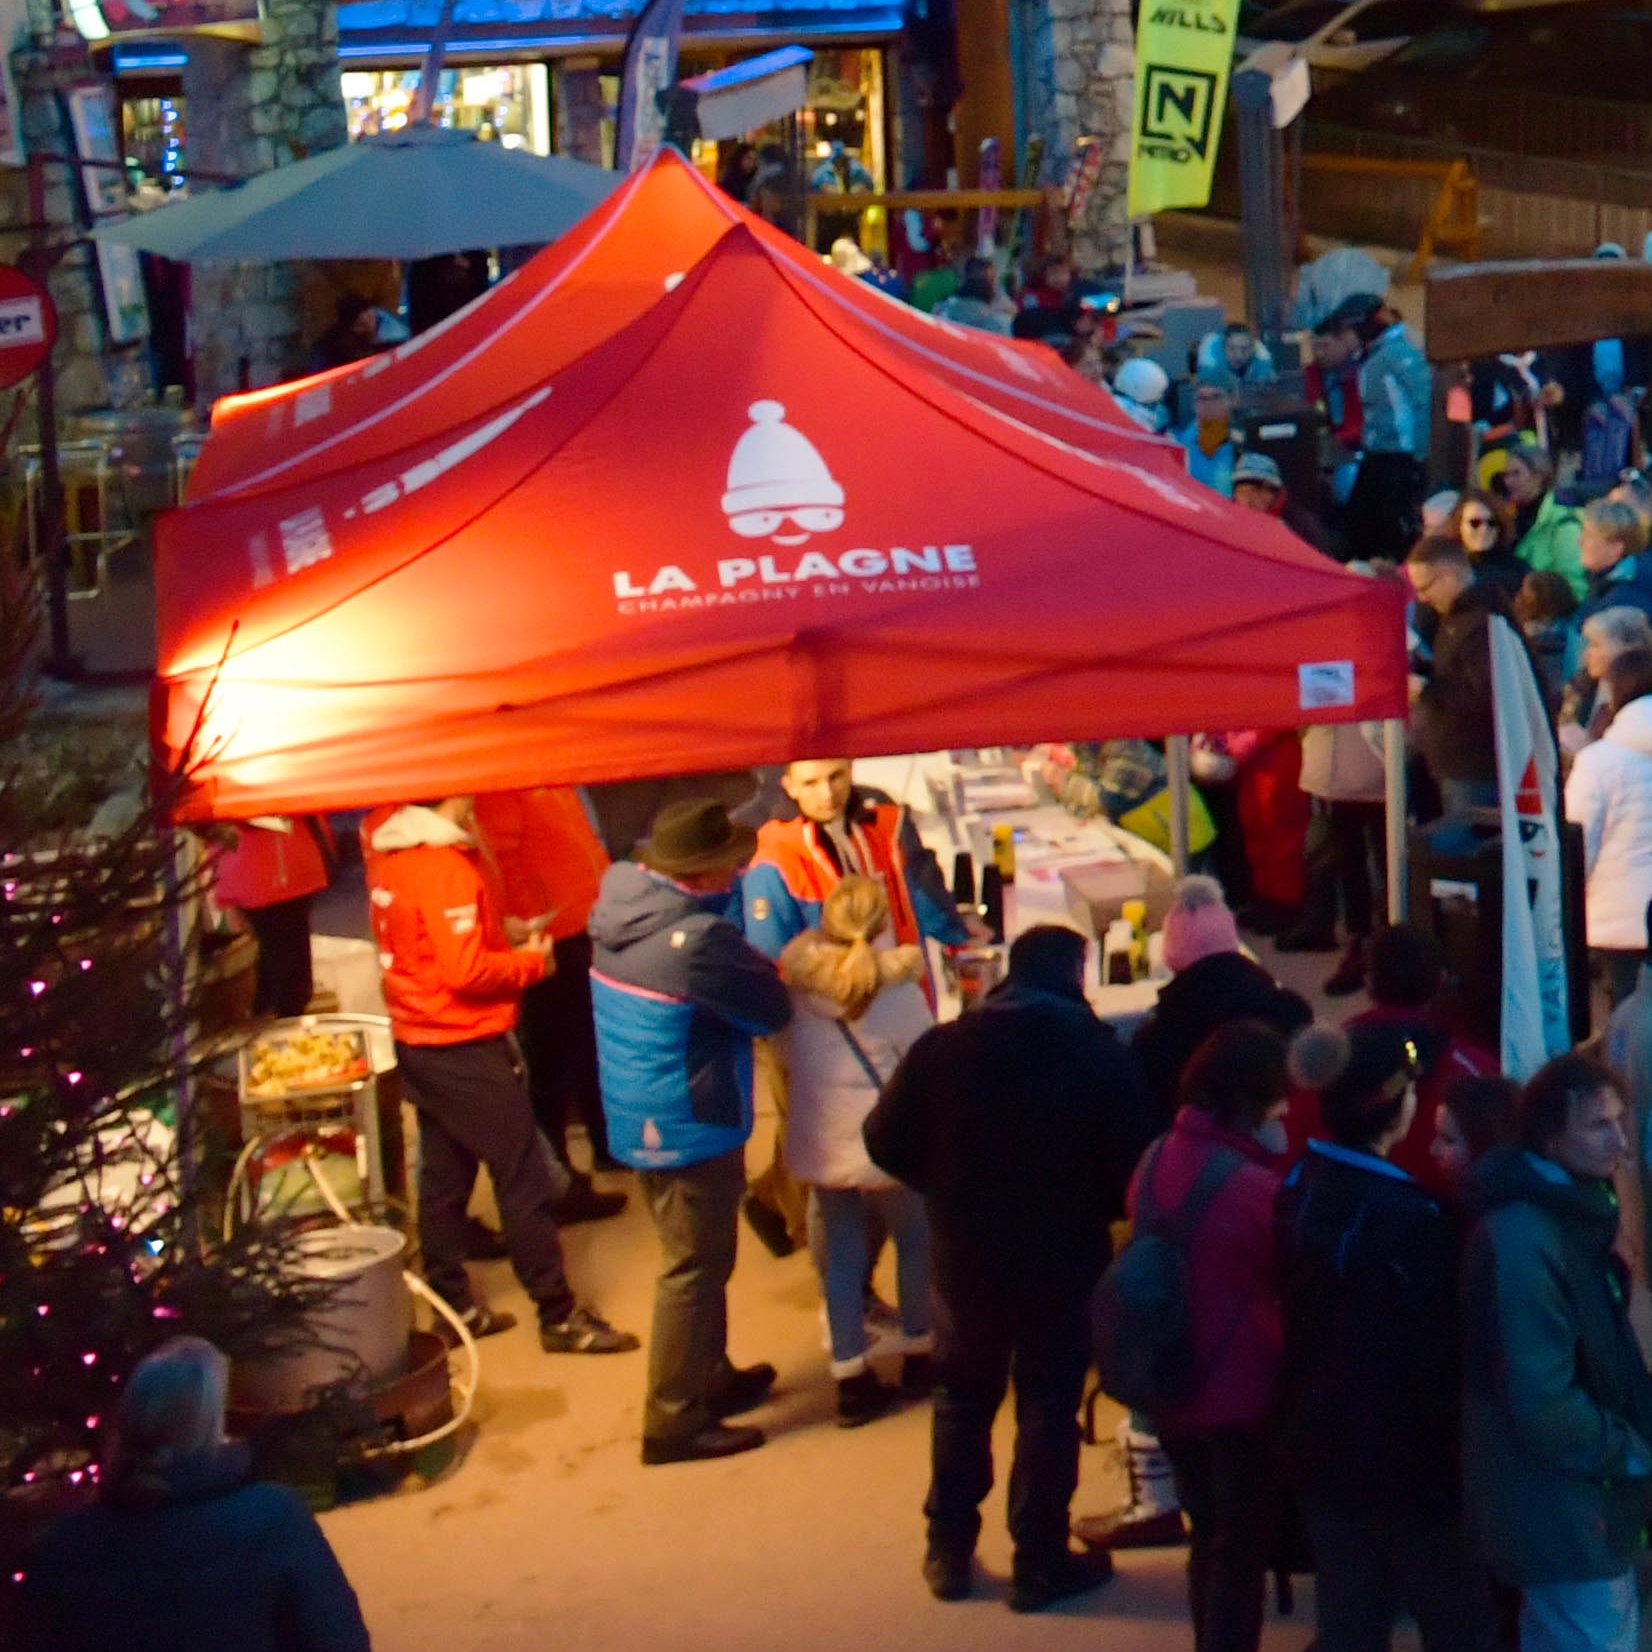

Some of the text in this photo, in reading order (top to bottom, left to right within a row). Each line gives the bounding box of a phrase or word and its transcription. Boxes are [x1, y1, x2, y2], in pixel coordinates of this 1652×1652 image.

[612, 543, 977, 599] LA PLAGNE
[616, 573, 981, 616] CHAMPAGNY EN VANOISE
